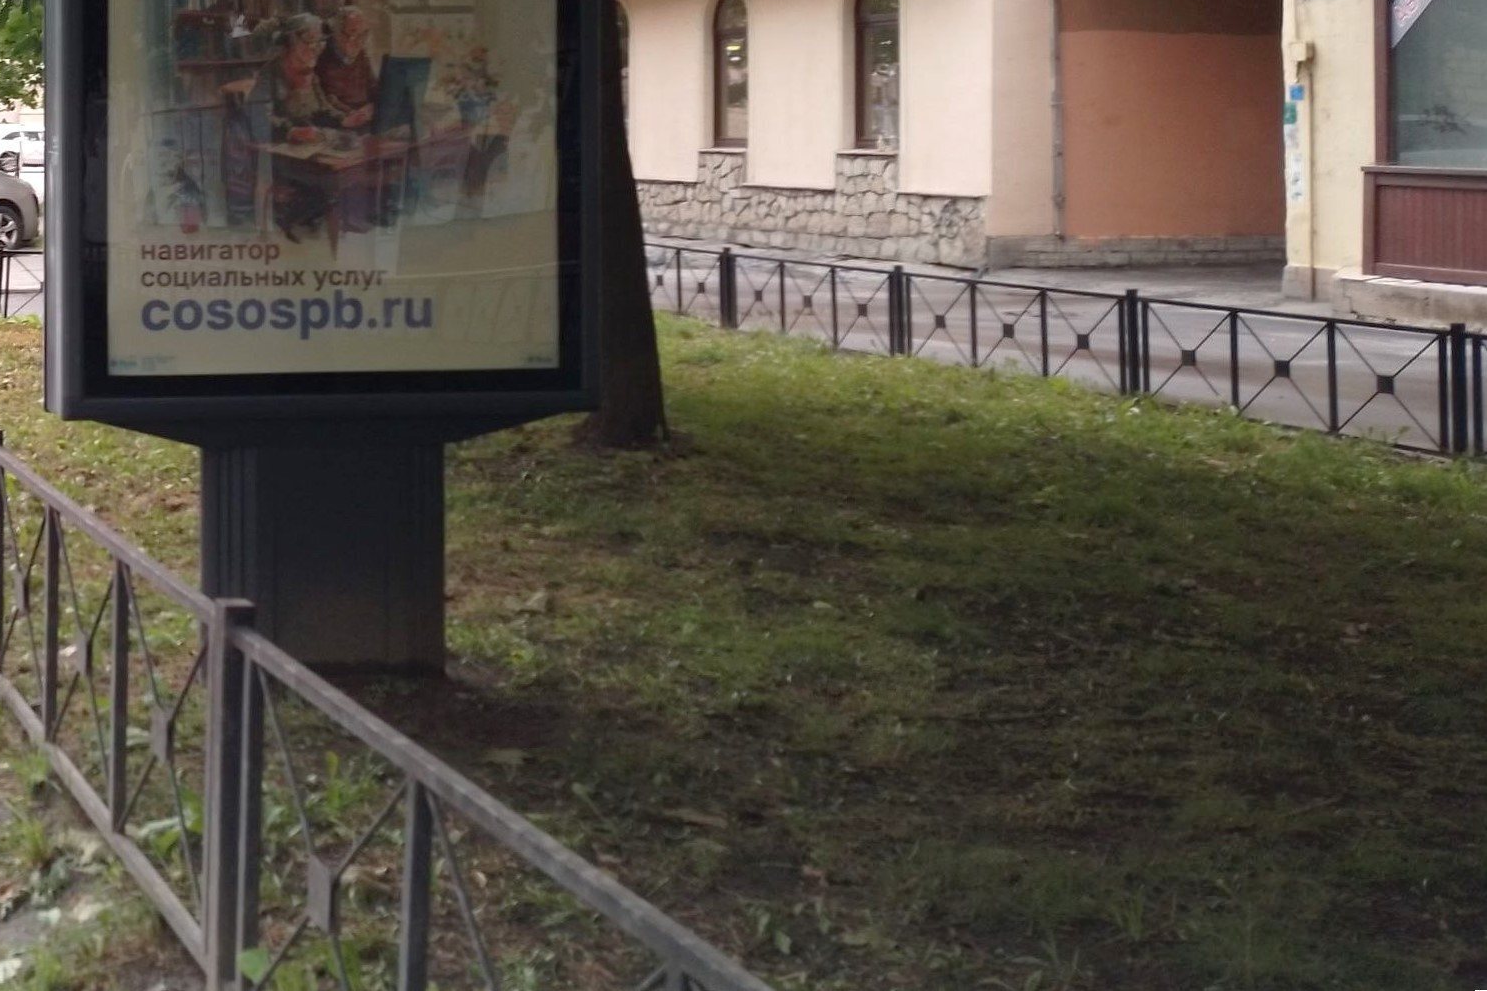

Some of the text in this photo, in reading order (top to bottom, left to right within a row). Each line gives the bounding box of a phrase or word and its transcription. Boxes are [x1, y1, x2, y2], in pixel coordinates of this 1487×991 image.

[140, 242, 281, 265] навигатор
[140, 268, 388, 291] социальных услуг
[141, 289, 433, 340] cosospb.ru
